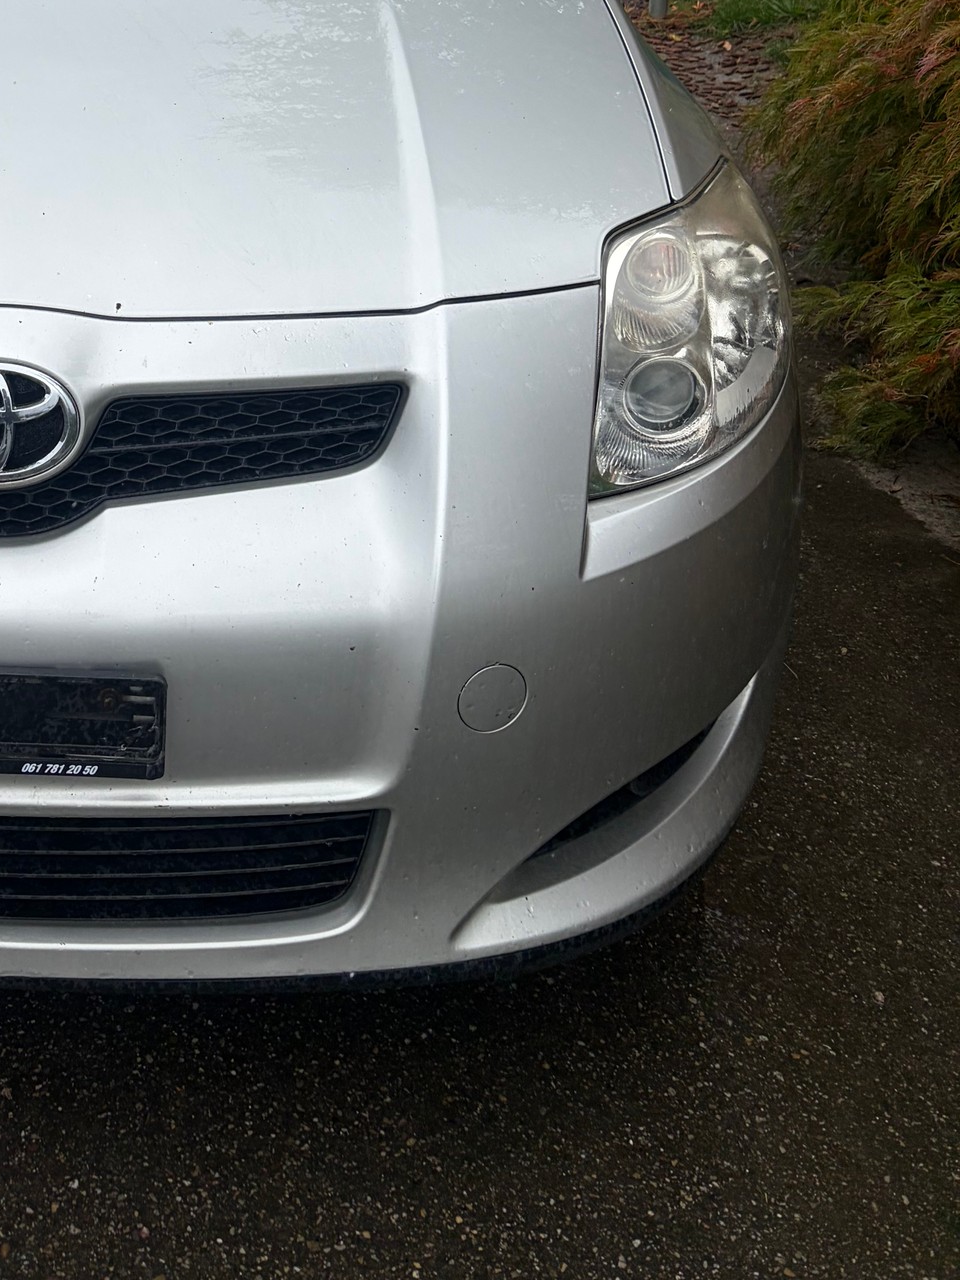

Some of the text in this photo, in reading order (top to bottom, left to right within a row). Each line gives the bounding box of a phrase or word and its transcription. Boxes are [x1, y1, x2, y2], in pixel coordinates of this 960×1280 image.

[21, 763, 43, 773] 061
[44, 763, 65, 774] 781
[66, 764, 82, 775] 20
[82, 765, 99, 775] 50
